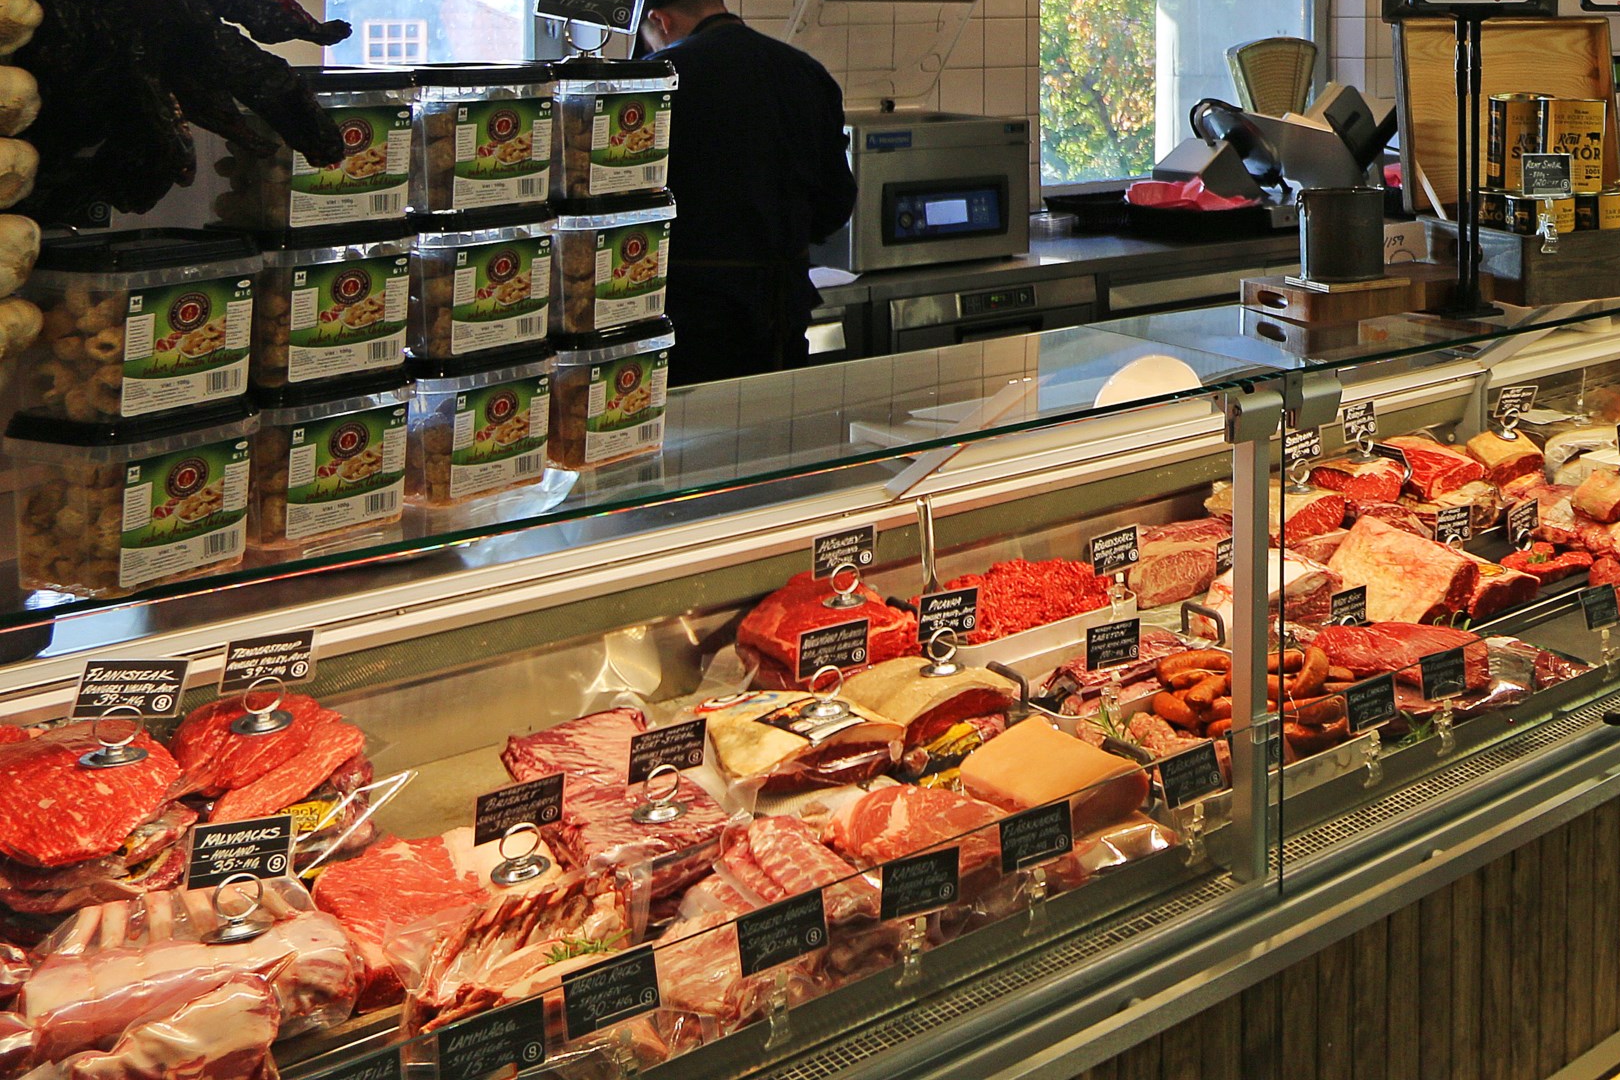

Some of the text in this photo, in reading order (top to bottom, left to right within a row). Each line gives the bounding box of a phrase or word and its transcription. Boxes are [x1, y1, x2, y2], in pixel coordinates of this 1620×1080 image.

[1558, 132, 1581, 145] Rent
[84, 667, 175, 682] FLANKSTEAK
[485, 789, 537, 811] BRISKET
[199, 827, 281, 849] KALVRACKS
